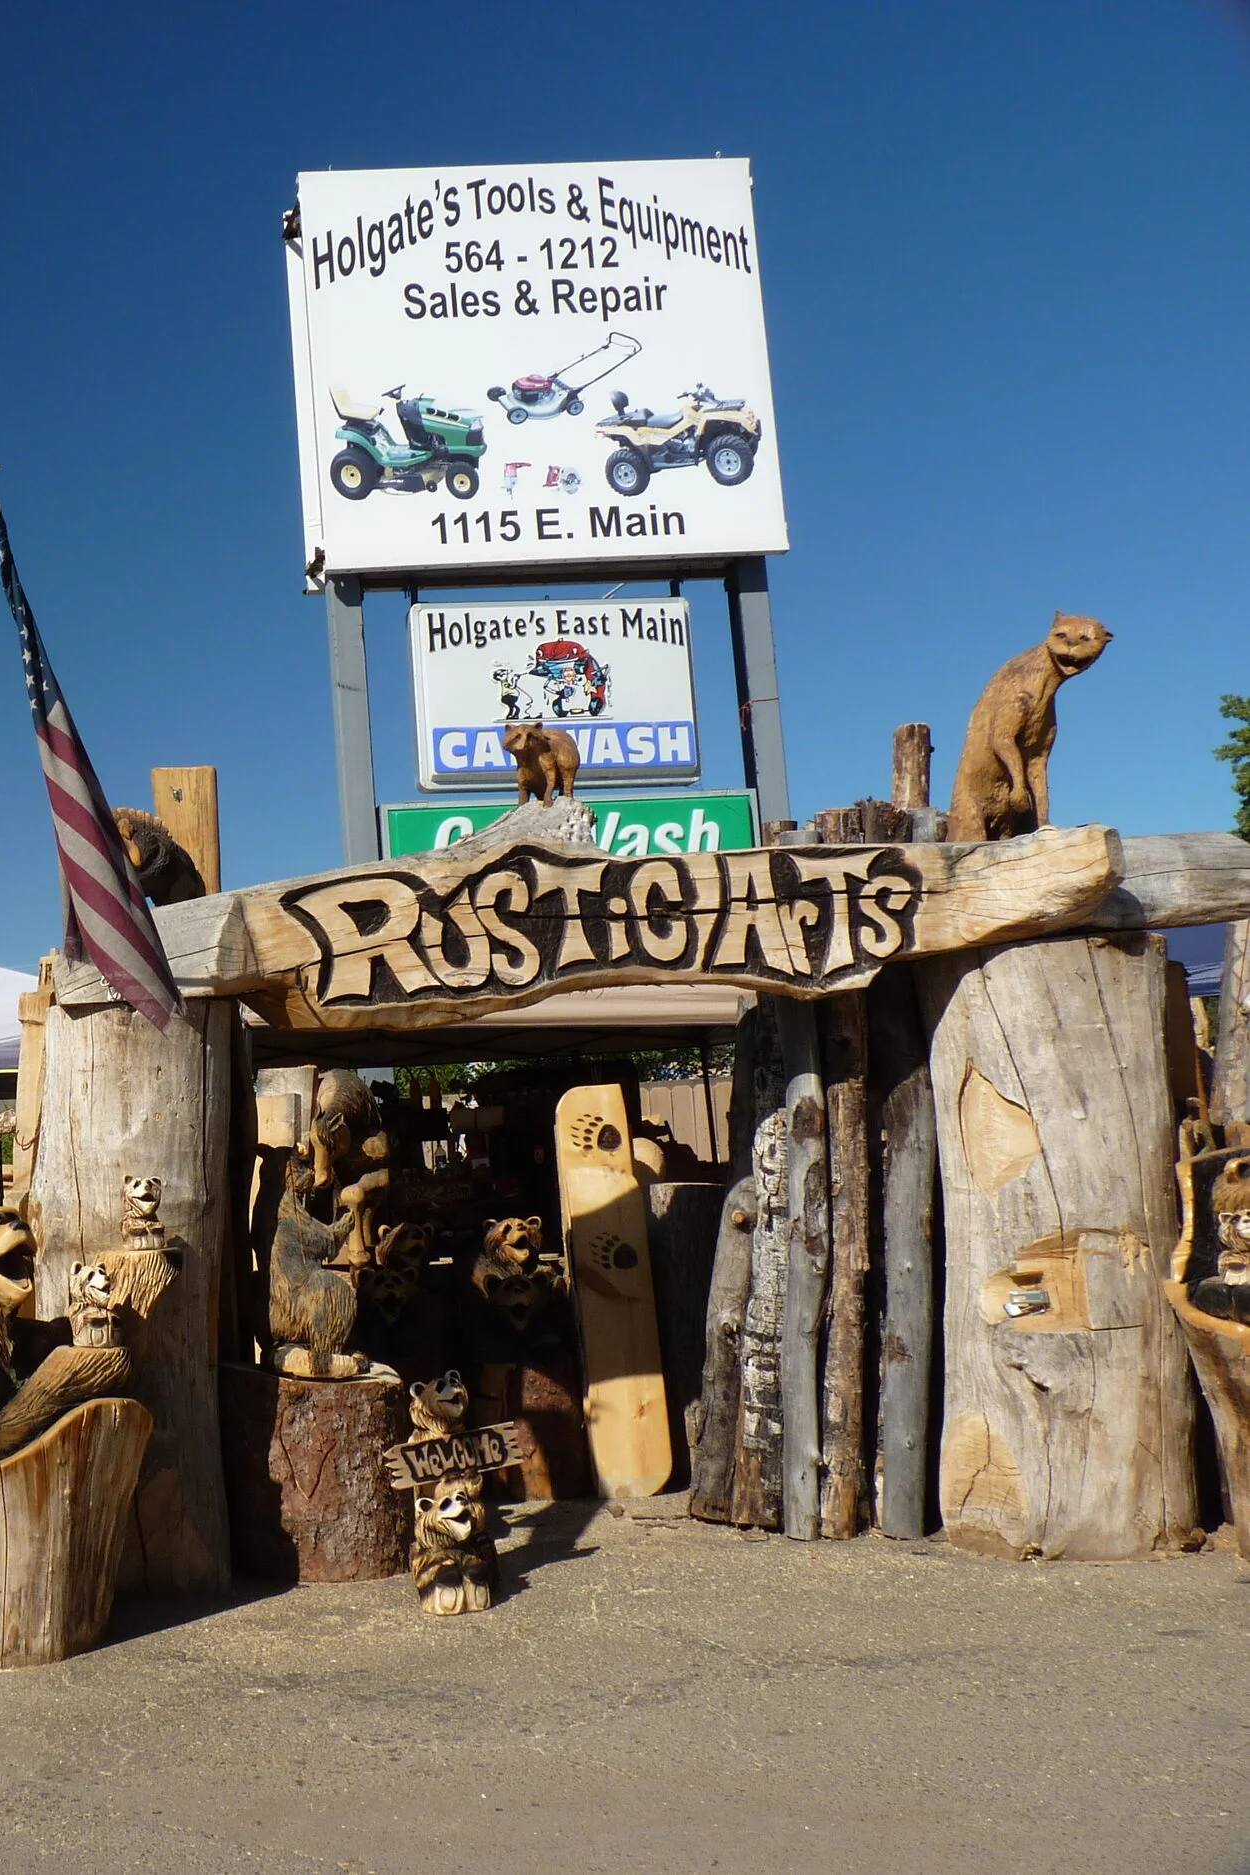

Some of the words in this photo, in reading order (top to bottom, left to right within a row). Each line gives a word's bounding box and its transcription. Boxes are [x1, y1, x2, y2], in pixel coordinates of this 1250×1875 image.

[312, 179, 462, 290] Holgate's
[467, 177, 556, 220] Tools
[566, 183, 591, 223] &
[598, 177, 752, 274] Equipment
[444, 239, 505, 273] 564
[539, 236, 620, 271] 1212
[403, 281, 501, 320] Sales
[514, 280, 540, 316] &
[551, 276, 668, 322] Repair
[431, 510, 521, 545] 1115
[536, 507, 573, 540] E.
[590, 505, 685, 538] Main
[426, 610, 546, 653] Holgate's
[556, 609, 610, 636] East
[619, 608, 685, 647] Main
[439, 731, 517, 769] CA
